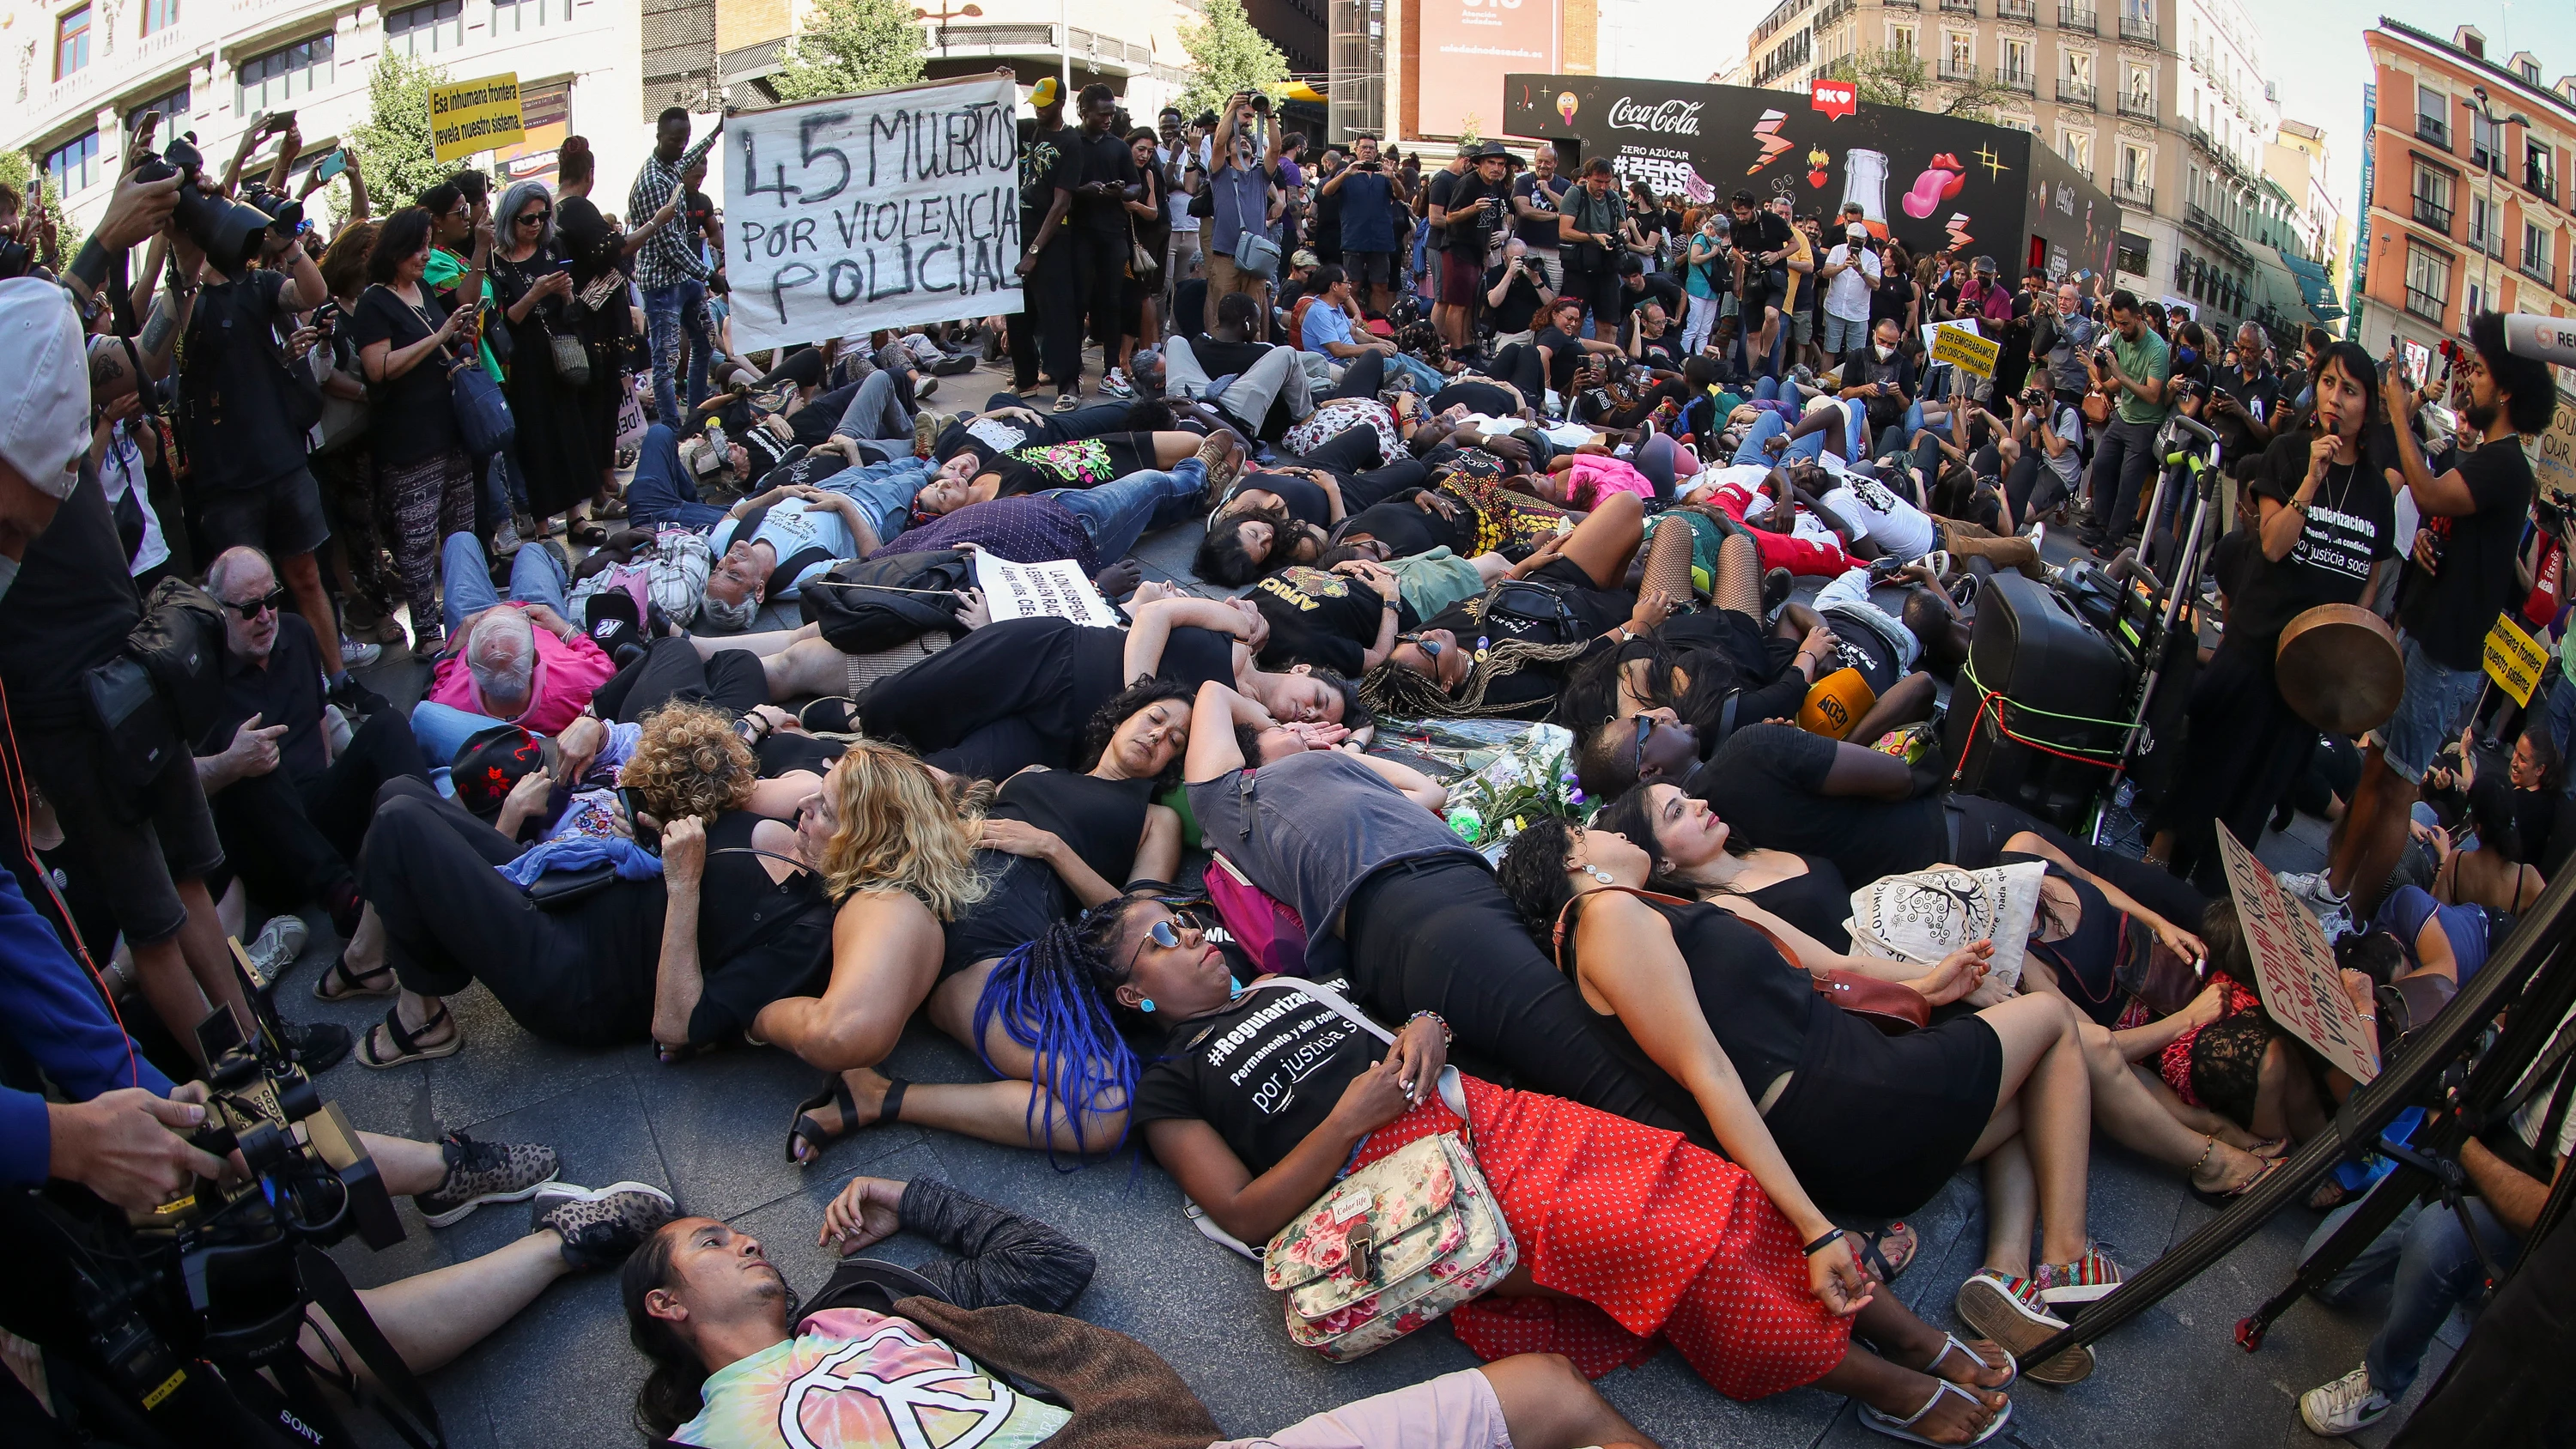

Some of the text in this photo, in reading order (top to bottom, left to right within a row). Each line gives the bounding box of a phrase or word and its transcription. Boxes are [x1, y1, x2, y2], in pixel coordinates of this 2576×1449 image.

[1461, 9, 1497, 19] Atención
[1461, 18, 1503, 27] ciudadana
[1439, 44, 1543, 58] soledadnodeseada.es
[434, 93, 449, 115] Esa
[449, 88, 488, 110] inhumana
[488, 82, 518, 102] frontera
[1815, 88, 1838, 103] 9K
[435, 113, 521, 147] revela nuestro sistema.
[1608, 96, 1705, 136] Coca-Cola
[741, 100, 1018, 208] 45 MUERTOS
[1620, 145, 1689, 161] ZERO AZÚCAR
[742, 186, 1019, 262] POR VIOLENCIA
[774, 240, 1023, 324] POLICIAL
[1935, 343, 1948, 355] HOY
[1938, 330, 1954, 343] AYER
[2557, 331, 2576, 348] RE
[1459, 453, 1488, 468] GUCCI
[2544, 433, 2570, 465] OUR
[2308, 543, 2345, 567] justicia
[1061, 589, 1092, 623] SUSPENDE
[2492, 620, 2542, 675] nhumana frontera
[2485, 646, 2530, 696] nuestro sistema.
[1996, 867, 2008, 882] que
[1997, 886, 2007, 910] nada
[2249, 853, 2290, 938] ASESINA
[2225, 830, 2301, 1028] ESPAÑA RACISTA
[2276, 881, 2348, 1046] VIDAS NEGRAS
[2278, 943, 2332, 1054] MASACRA
[2305, 919, 2374, 1080] EN MELILLA
[1230, 1018, 1316, 1087] Permanente y sin
[1252, 1029, 1346, 1114] por justicia
[1337, 1197, 1367, 1216] Color life
[248, 1337, 288, 1358] SONY
[280, 1410, 324, 1446] SONY
